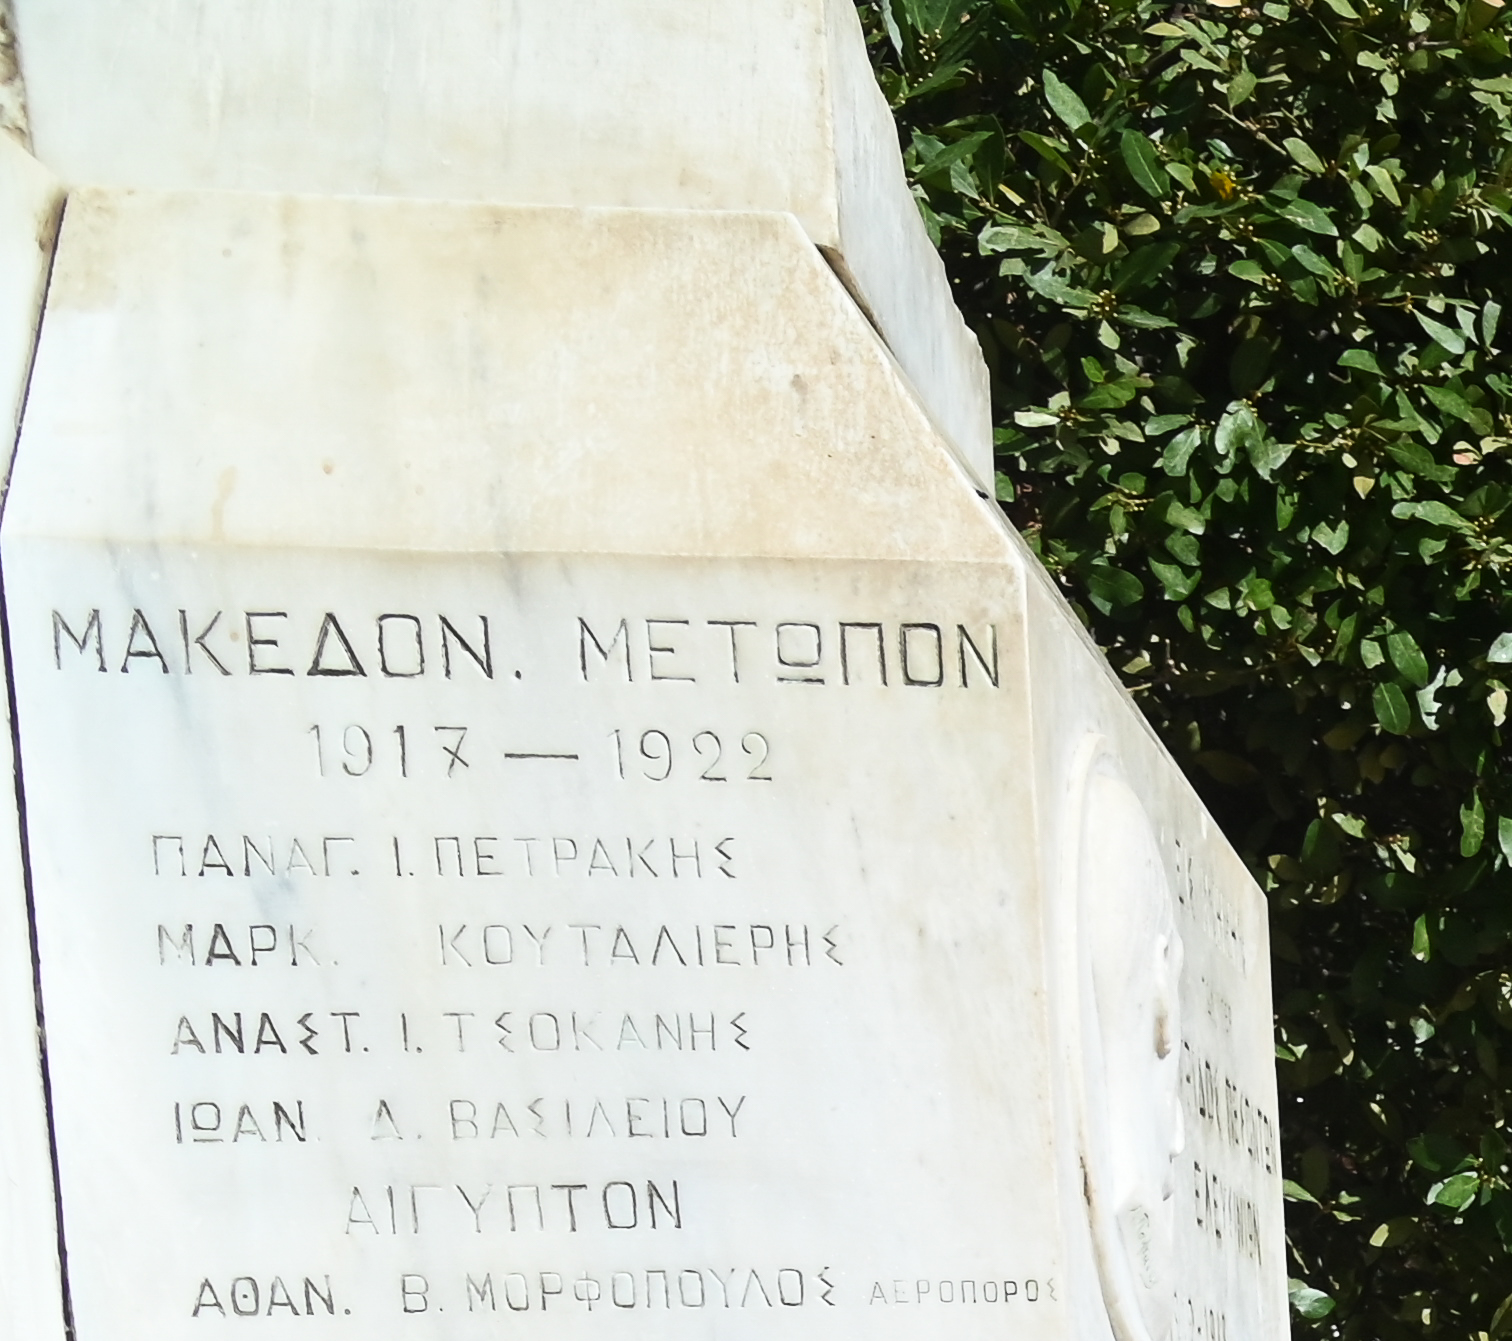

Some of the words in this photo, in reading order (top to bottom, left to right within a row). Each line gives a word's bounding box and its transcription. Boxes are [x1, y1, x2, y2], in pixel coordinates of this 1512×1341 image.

[51, 607, 524, 681] ΜΑΚΕΔΟΝ.
[579, 615, 1002, 690] ΜΕΤΩΠΟΝ
[307, 722, 471, 779] 1917
[608, 727, 776, 784] 1922
[169, 1011, 370, 1056] ΑΝΑΣΤ.
[191, 1273, 352, 1320] ΑΘΑΝ.
